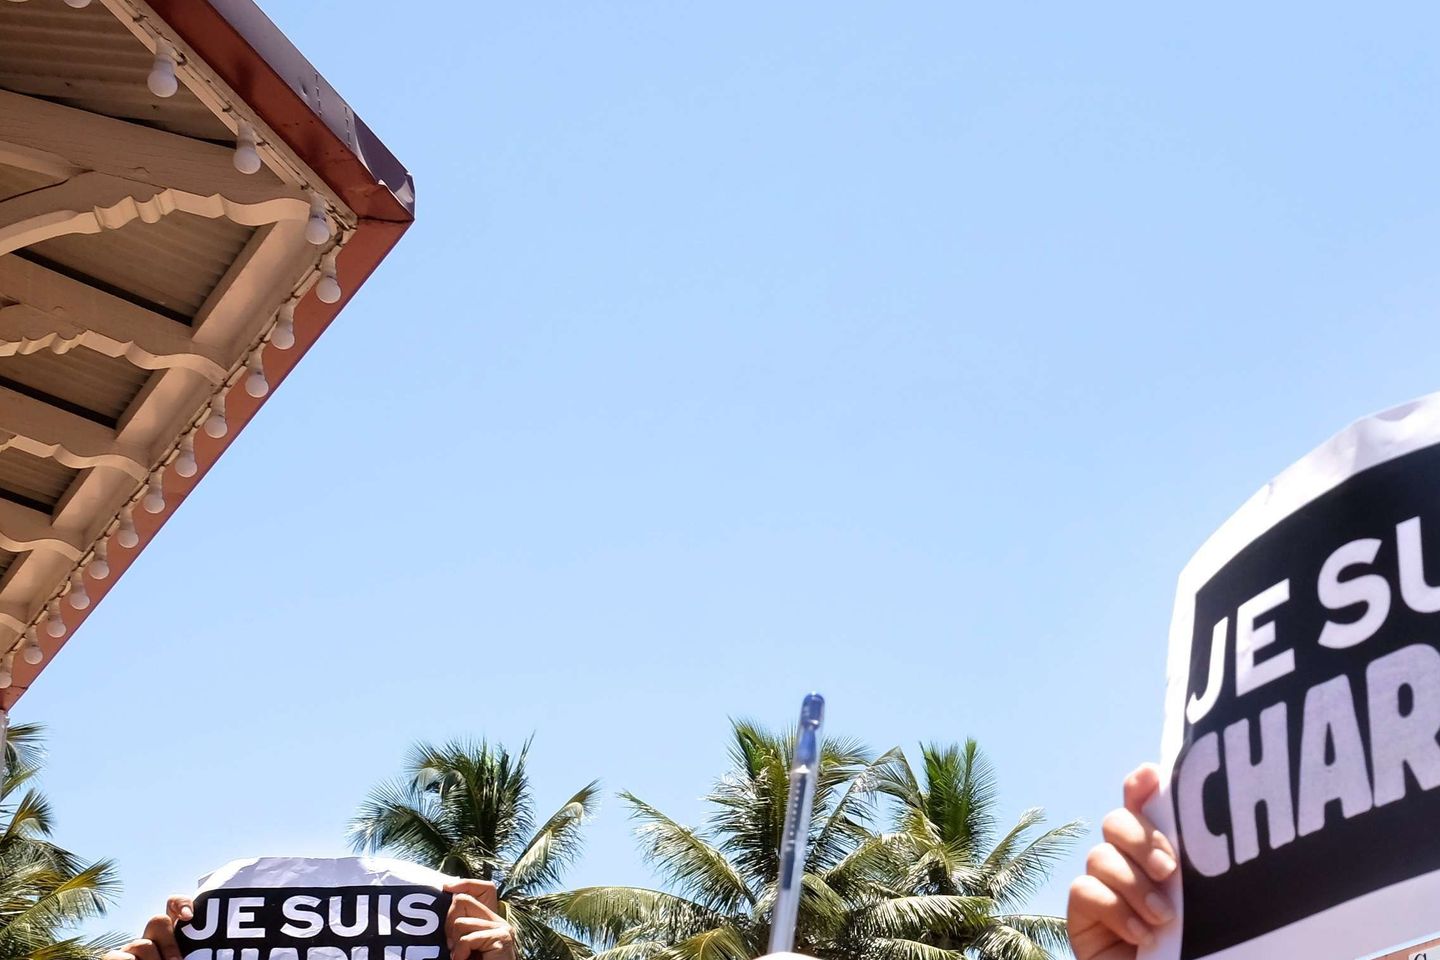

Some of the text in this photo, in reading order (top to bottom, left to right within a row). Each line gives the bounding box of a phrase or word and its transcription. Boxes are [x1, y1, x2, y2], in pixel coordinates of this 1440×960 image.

[1185, 578, 1296, 725] JE
[181, 893, 440, 941] JE SUIS
